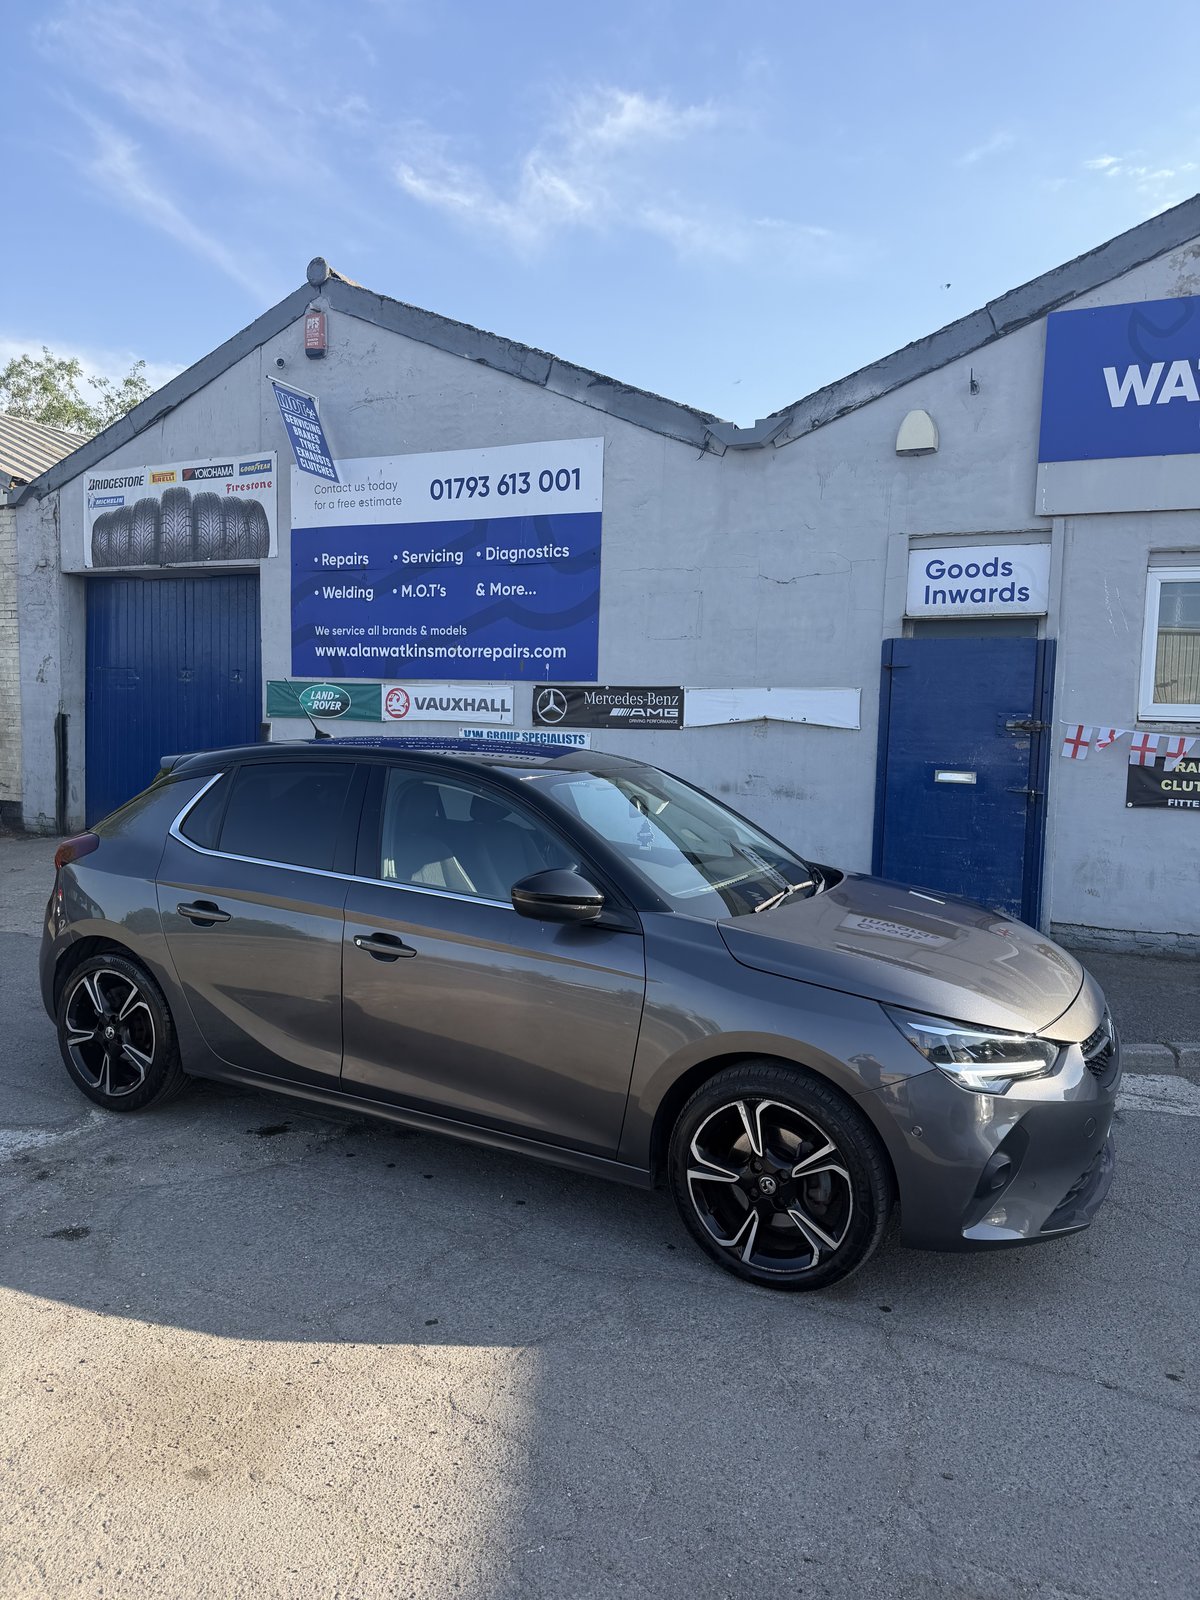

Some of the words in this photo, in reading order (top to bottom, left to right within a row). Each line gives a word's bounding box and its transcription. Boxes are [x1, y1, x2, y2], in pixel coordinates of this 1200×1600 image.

[1103, 358, 1200, 408] WA
[276, 390, 308, 417] MOT
[284, 412, 321, 435] SERVICING
[292, 426, 321, 444] BRAKES
[299, 437, 321, 454] TYRES
[295, 446, 332, 467] EXHAUSTS
[194, 466, 234, 479] YOKOHAMA
[240, 462, 271, 474] GOODYEAR
[300, 457, 335, 478] CLUTCHES
[88, 475, 144, 491] BRIDGESTONE
[152, 472, 175, 483] PIRELLI
[430, 476, 489, 500] 01793
[497, 472, 530, 495] 613
[539, 468, 581, 492] 001
[226, 480, 272, 494] Firestone
[314, 482, 351, 495] Contact
[354, 483, 366, 492] us
[368, 480, 398, 494] today
[95, 497, 124, 505] MICHELIN
[314, 499, 326, 510] for
[329, 501, 335, 510] a
[338, 498, 356, 509] free
[359, 496, 402, 508] estimate
[322, 553, 369, 567] Repairs
[402, 550, 464, 565] Servicing
[486, 544, 570, 562] Diagnostics
[925, 557, 1013, 579] Goods
[323, 586, 374, 602] Welding
[401, 584, 447, 597] M.O.T's
[475, 583, 485, 596] &
[490, 583, 537, 596] More...
[924, 582, 1030, 605] Inwards
[315, 626, 330, 636] We
[332, 626, 365, 636] service
[368, 625, 380, 636] all
[382, 626, 418, 636] brands
[421, 626, 427, 636] &
[431, 625, 467, 636] models
[315, 643, 567, 661] www.alanwatkinsmotorrepairs.com
[310, 690, 335, 701] LAND
[584, 691, 679, 705] Mercedes-Benz
[312, 700, 342, 711] ROVER
[414, 697, 511, 713] VAUXHALL
[629, 708, 679, 717] AMG
[464, 729, 484, 738] VW
[486, 731, 520, 740] GROUP
[521, 731, 585, 745] SPECIALISTS
